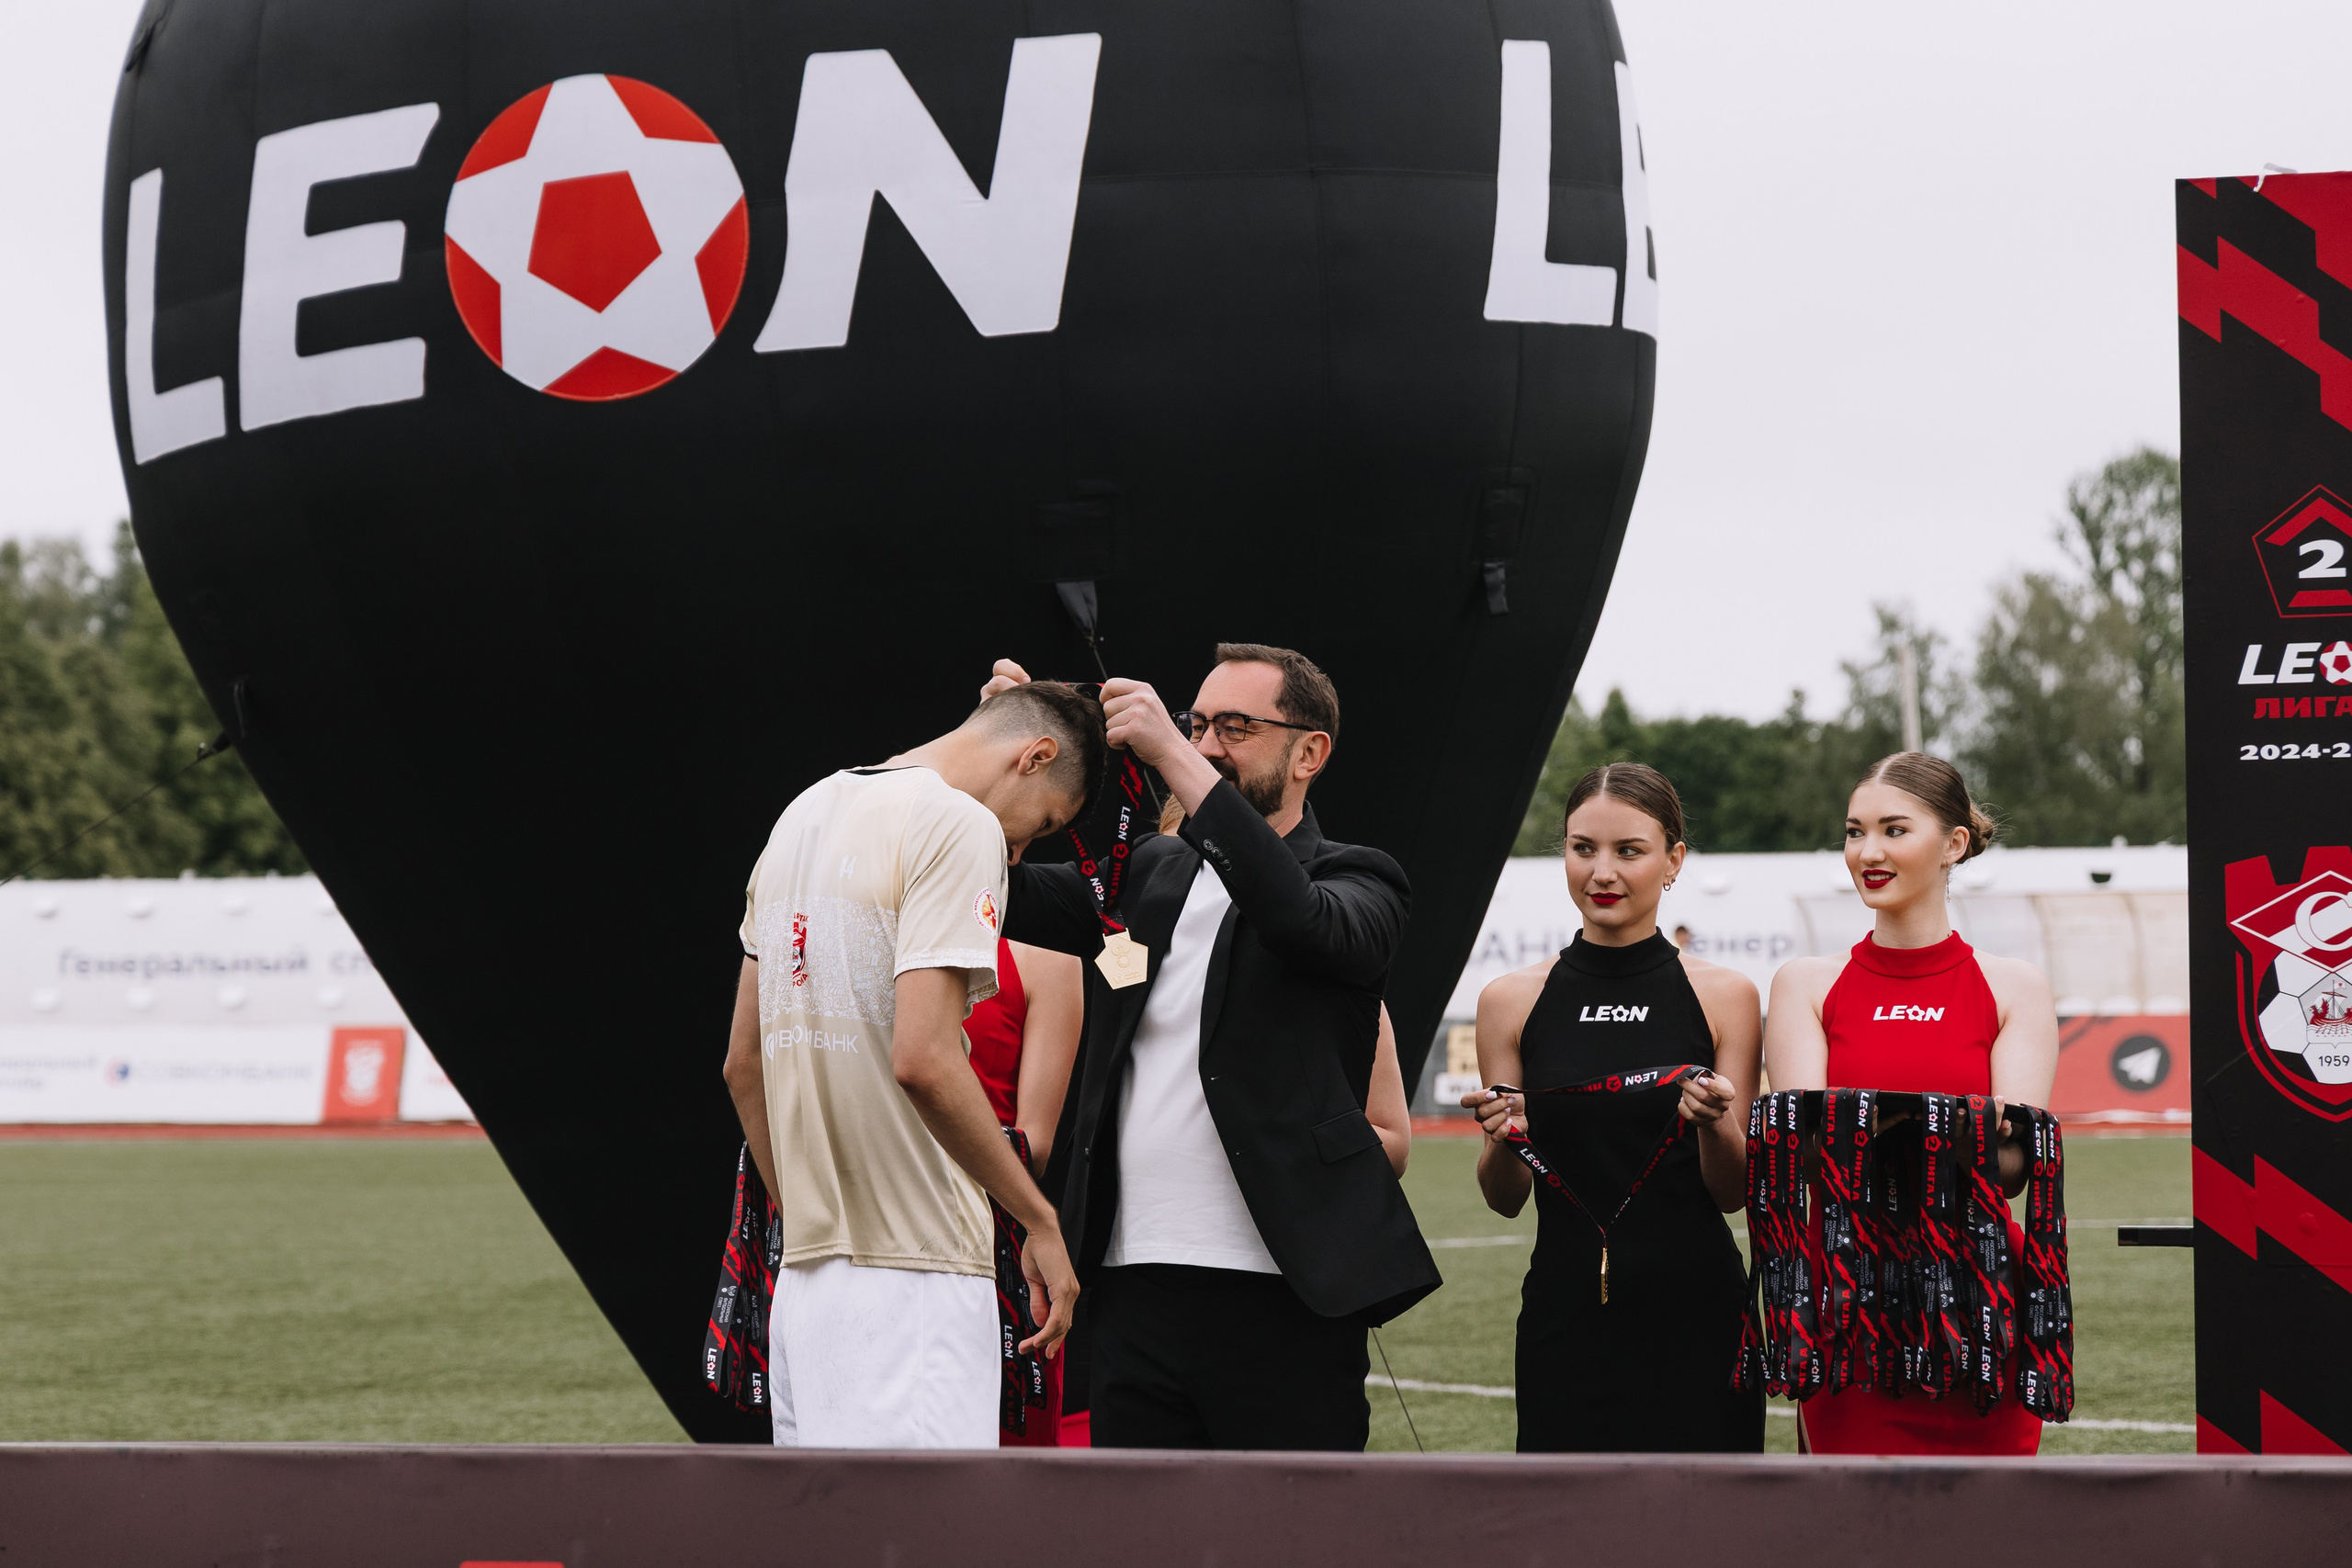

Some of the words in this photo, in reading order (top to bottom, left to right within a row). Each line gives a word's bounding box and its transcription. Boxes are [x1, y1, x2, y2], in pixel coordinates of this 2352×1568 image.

[1482, 39, 1657, 342] LE
[125, 33, 1102, 464] LEON
[2298, 539, 2347, 579] 2
[2237, 640, 2352, 686] LEO
[1118, 806, 1130, 840] LEON
[1110, 862, 1122, 897] ЛИГА
[1578, 1005, 1649, 1022] LEON
[1872, 1004, 1945, 1022] LEON
[2318, 1055, 2349, 1067] 1959
[1624, 1071, 1658, 1087] LEON
[1770, 1092, 1780, 1125] LEON
[1788, 1095, 1796, 1130] LEON
[1826, 1093, 1837, 1133] ЛИГА
[1858, 1091, 1870, 1128] LEON
[1928, 1096, 1939, 1133] LEON
[1974, 1114, 1985, 1153] ЛИГА
[1520, 1147, 1548, 1174] LEON
[1769, 1149, 1777, 1187] ЛИГА
[1853, 1149, 1863, 1189] ЛИГА
[1926, 1156, 1936, 1193] ЛИГА
[1842, 1302, 1850, 1329] ИГА
[1983, 1305, 1991, 1342] LEON
[1004, 1325, 1013, 1359] LEON
[707, 1348, 718, 1380] LEON
[1032, 1360, 1041, 1393] LEON
[1799, 1360, 1807, 1387] ИГА
[1904, 1346, 1912, 1380] LEON
[1982, 1346, 1991, 1382] LEON
[752, 1372, 763, 1404] LEON
[2027, 1370, 2037, 1405] LEON
